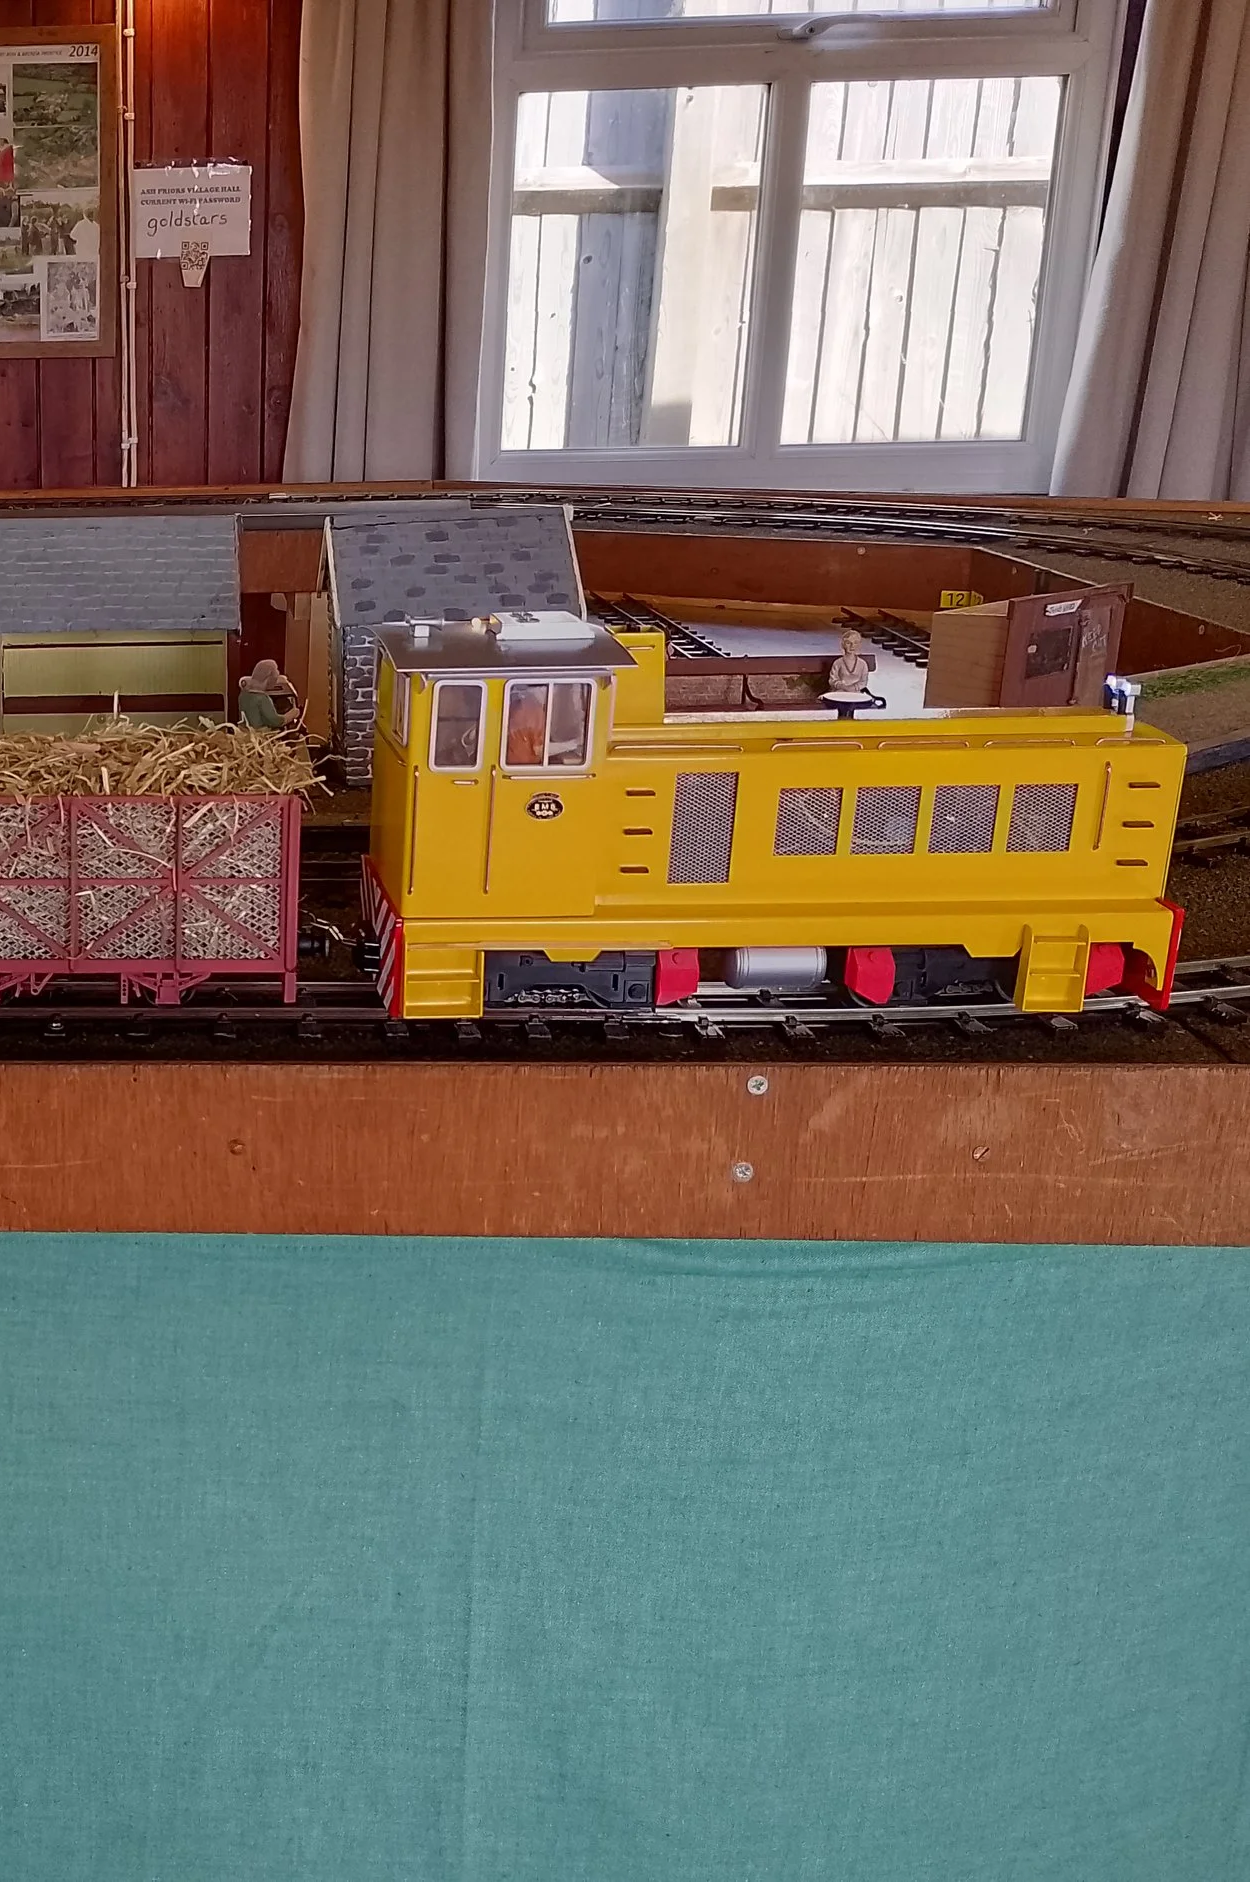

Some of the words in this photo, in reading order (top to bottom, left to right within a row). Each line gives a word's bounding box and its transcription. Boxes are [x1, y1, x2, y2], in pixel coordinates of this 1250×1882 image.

[68, 45, 99, 57] 2014
[158, 187, 186, 195] PRIORS
[187, 186, 220, 194] VILLAGE
[140, 198, 177, 206] CURRENT
[198, 196, 241, 204] PASSWORD
[146, 209, 228, 237] goldstars
[946, 592, 966, 606] 12
